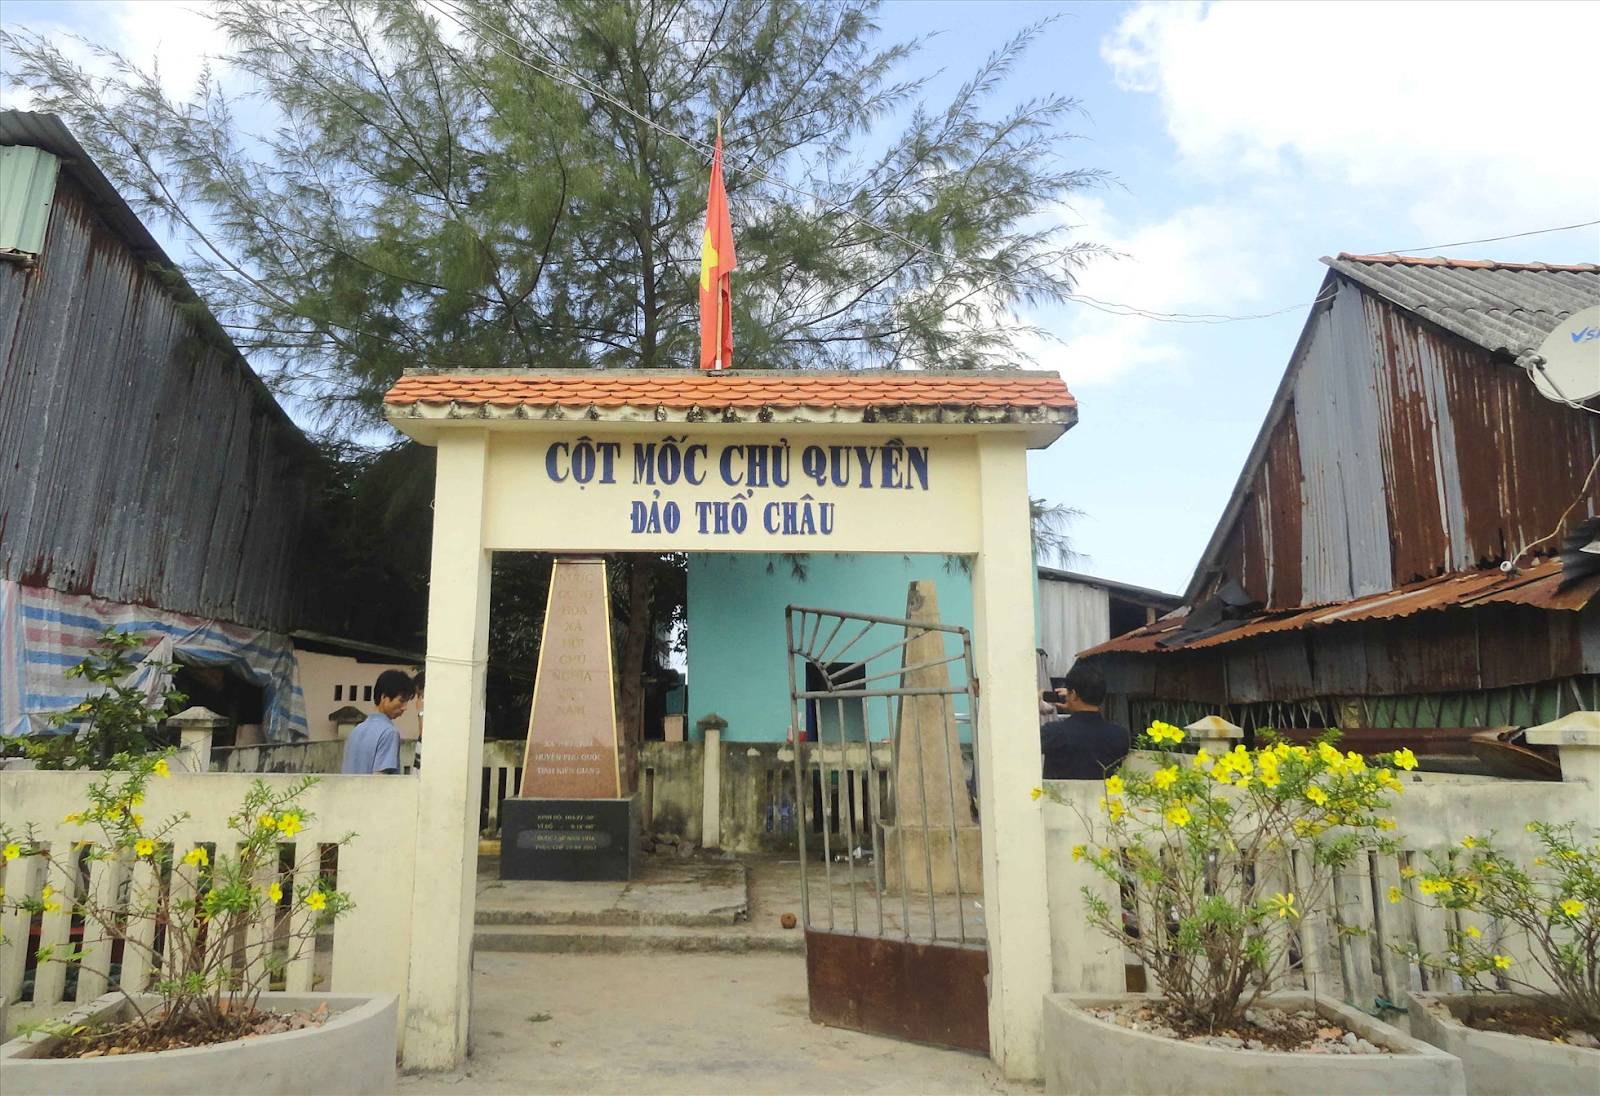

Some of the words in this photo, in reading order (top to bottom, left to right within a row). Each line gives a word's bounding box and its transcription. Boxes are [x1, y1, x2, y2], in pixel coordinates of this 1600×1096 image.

[545, 435, 620, 491] CỘT
[633, 434, 708, 486] MỐC
[719, 437, 791, 488] CHỦ
[801, 436, 929, 490] QUYỀN
[630, 489, 681, 534] ĐẢO
[695, 489, 753, 535] THỔ
[763, 493, 836, 535] CHÂU
